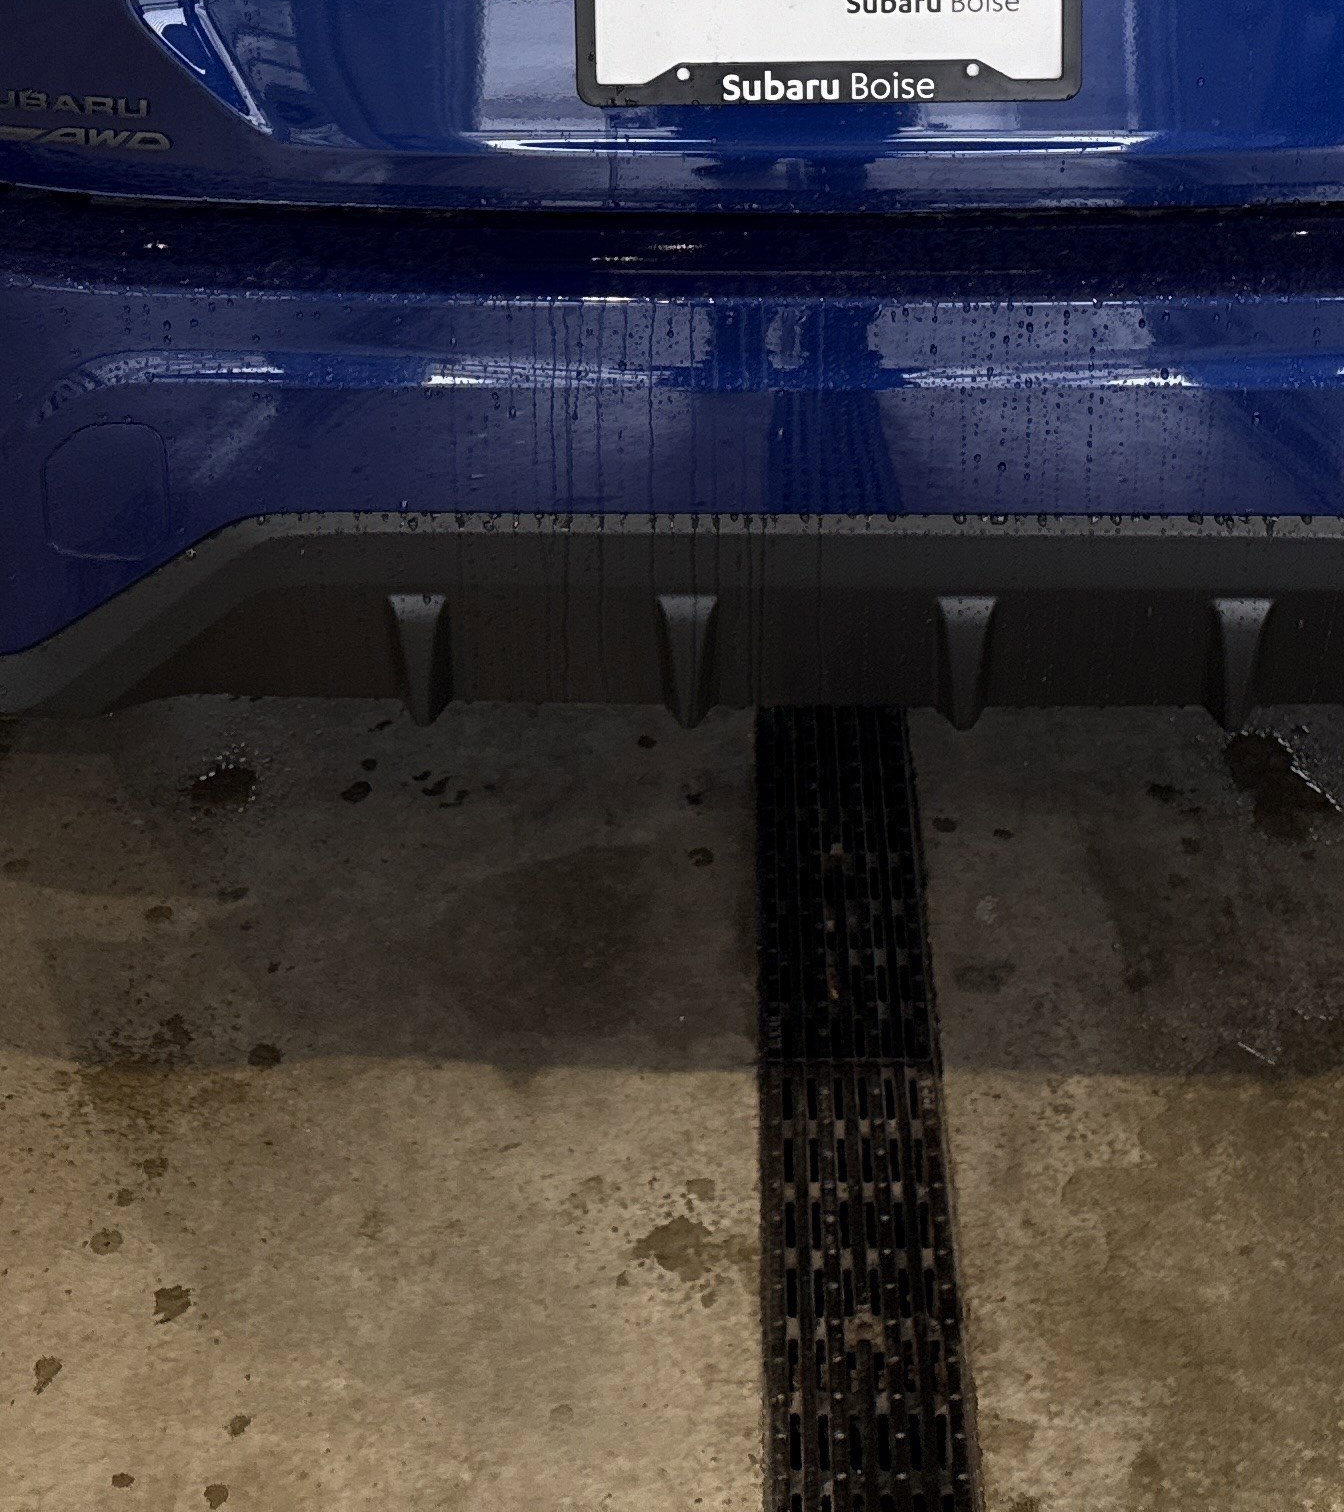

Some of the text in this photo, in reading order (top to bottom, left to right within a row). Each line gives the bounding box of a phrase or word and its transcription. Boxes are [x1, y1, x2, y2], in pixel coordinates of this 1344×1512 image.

[722, 70, 935, 101] Subaru Boise
[39, 126, 172, 151] AWD
